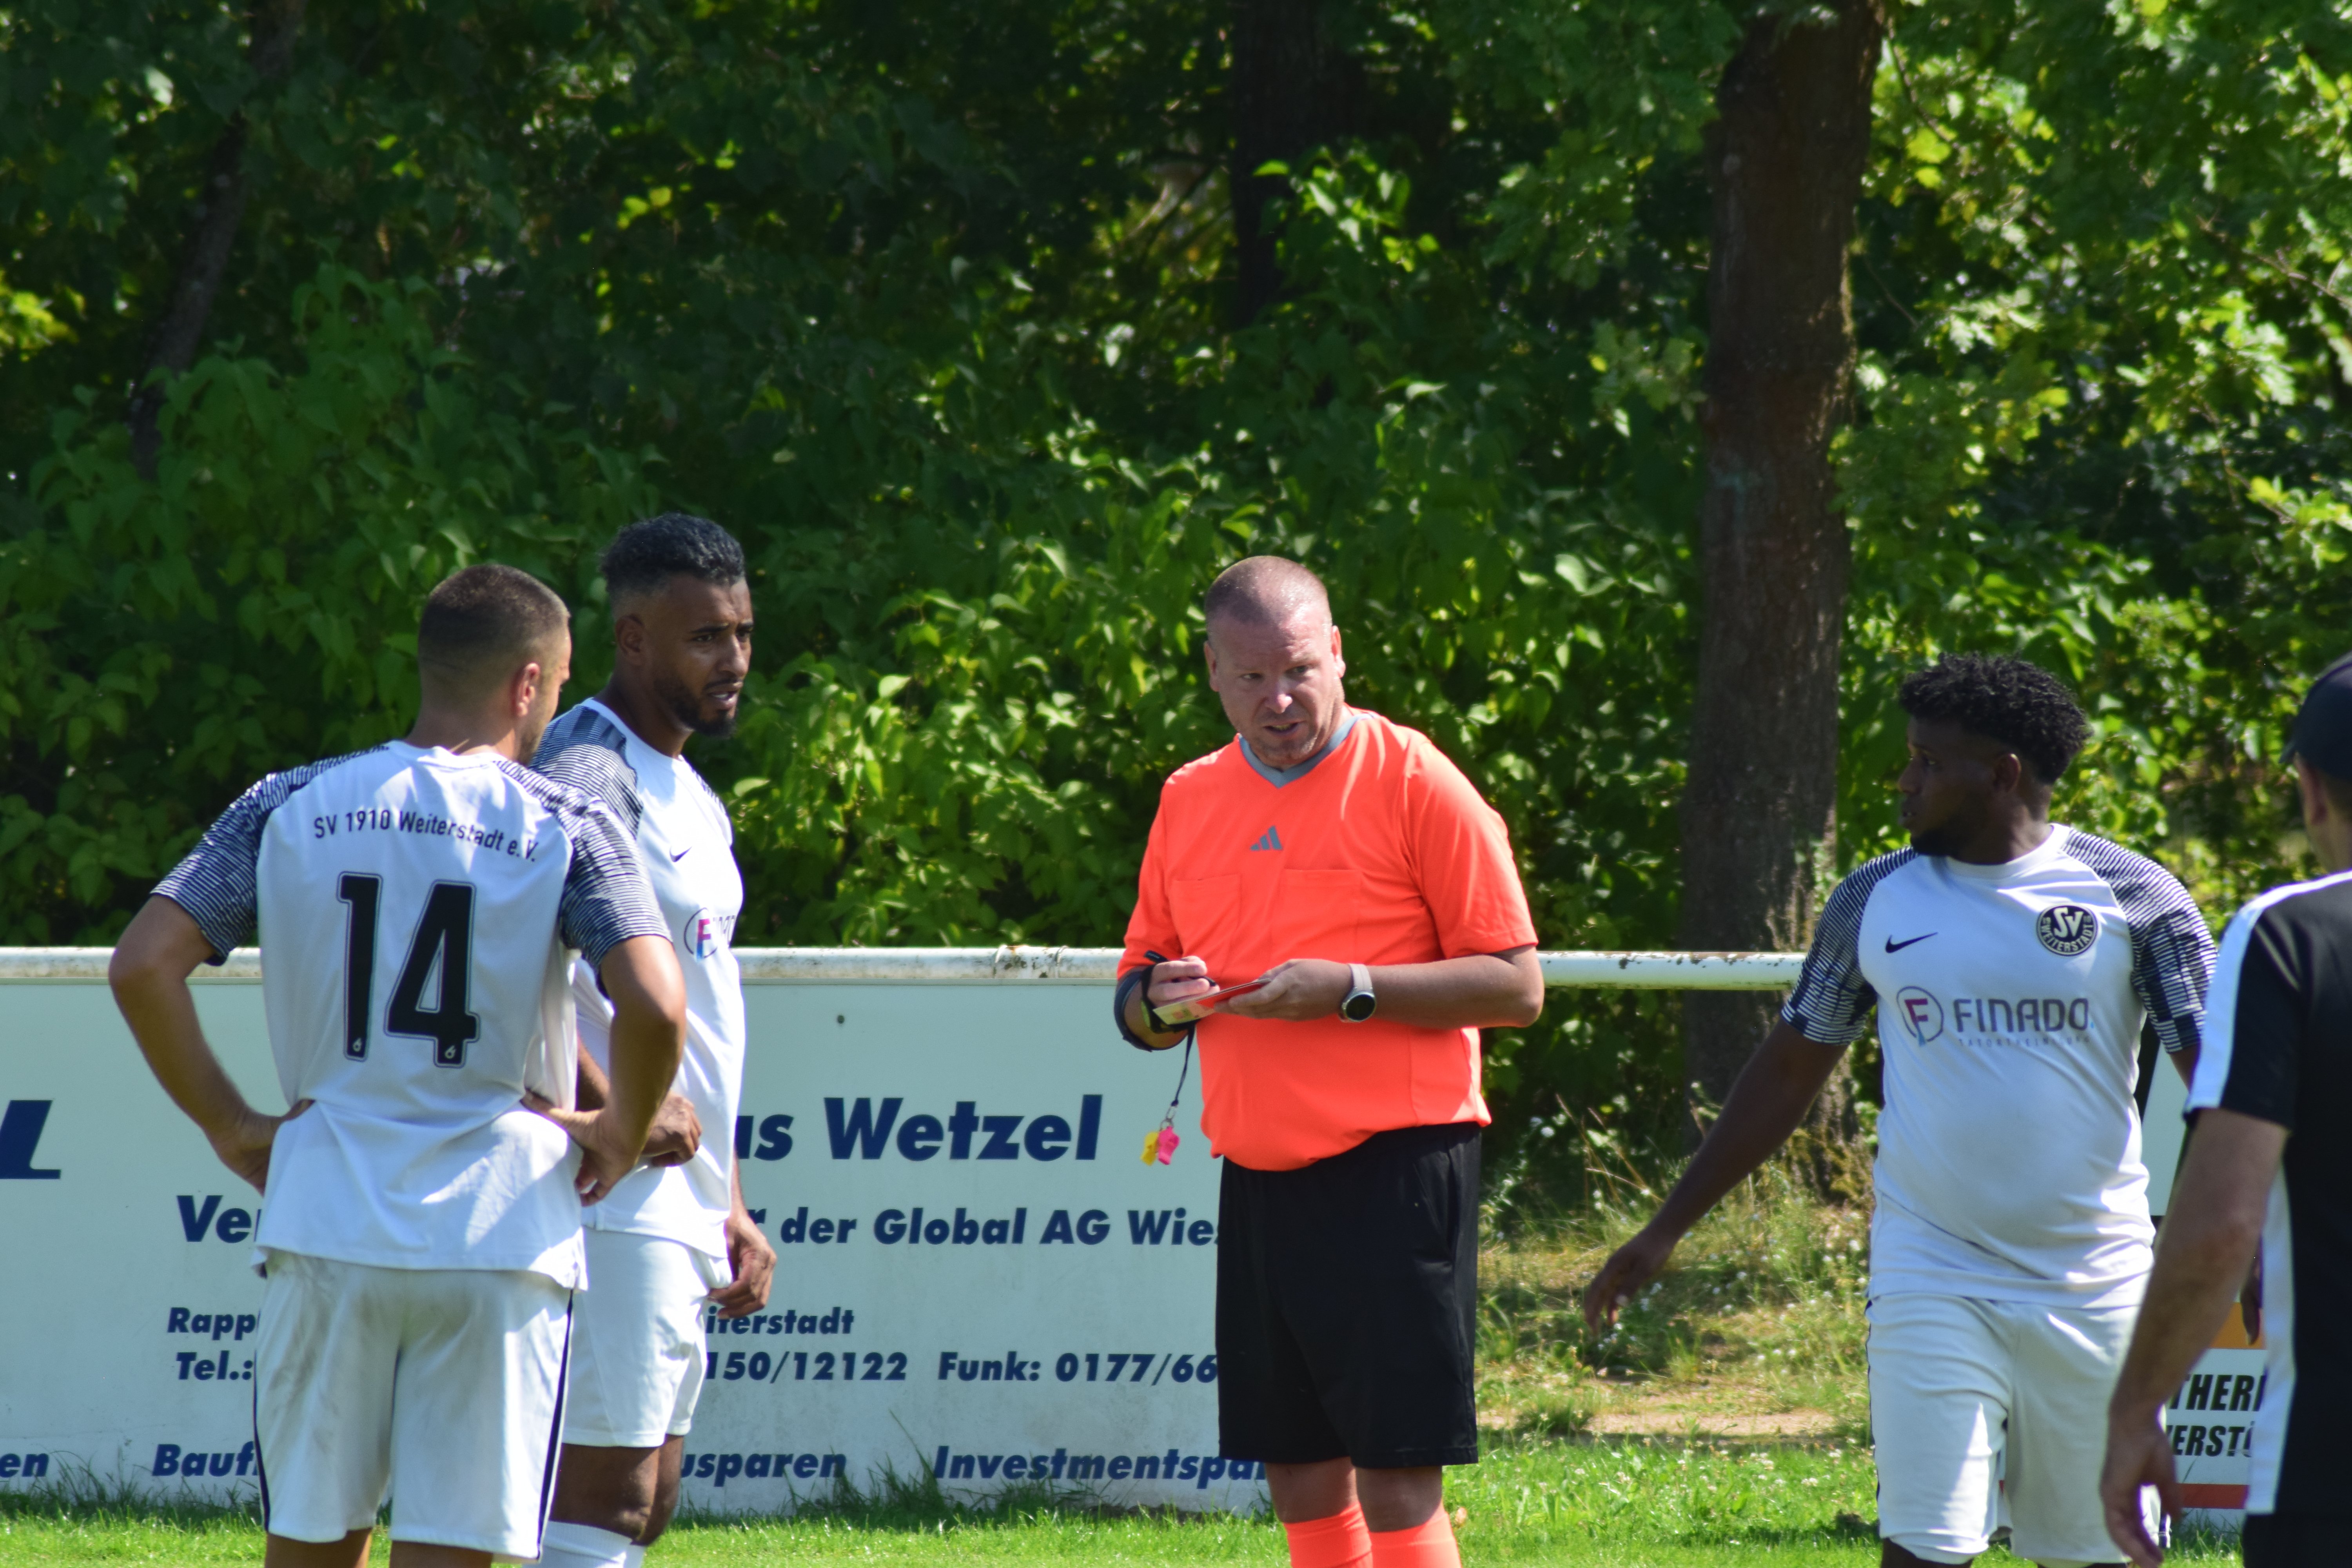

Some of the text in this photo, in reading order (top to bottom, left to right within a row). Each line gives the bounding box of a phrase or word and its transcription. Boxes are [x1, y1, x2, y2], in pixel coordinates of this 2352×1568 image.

[314, 814, 337, 838] SV
[345, 809, 390, 832] 1910
[399, 811, 504, 851] Weiterstadt
[2053, 907, 2084, 934] SV
[337, 871, 480, 1068] 14
[824, 1094, 1103, 1161] Wetzel
[176, 1195, 262, 1243] Ve
[780, 1207, 857, 1244] der
[874, 1207, 1027, 1245] Global
[1039, 1209, 1111, 1245] AG
[1127, 1207, 1218, 1246] Wie
[176, 1350, 253, 1380] Tel.:
[937, 1351, 1041, 1381] Funk:
[1055, 1352, 1218, 1386] 0177/66
[0, 1453, 49, 1477] en
[152, 1440, 258, 1477] Bauf
